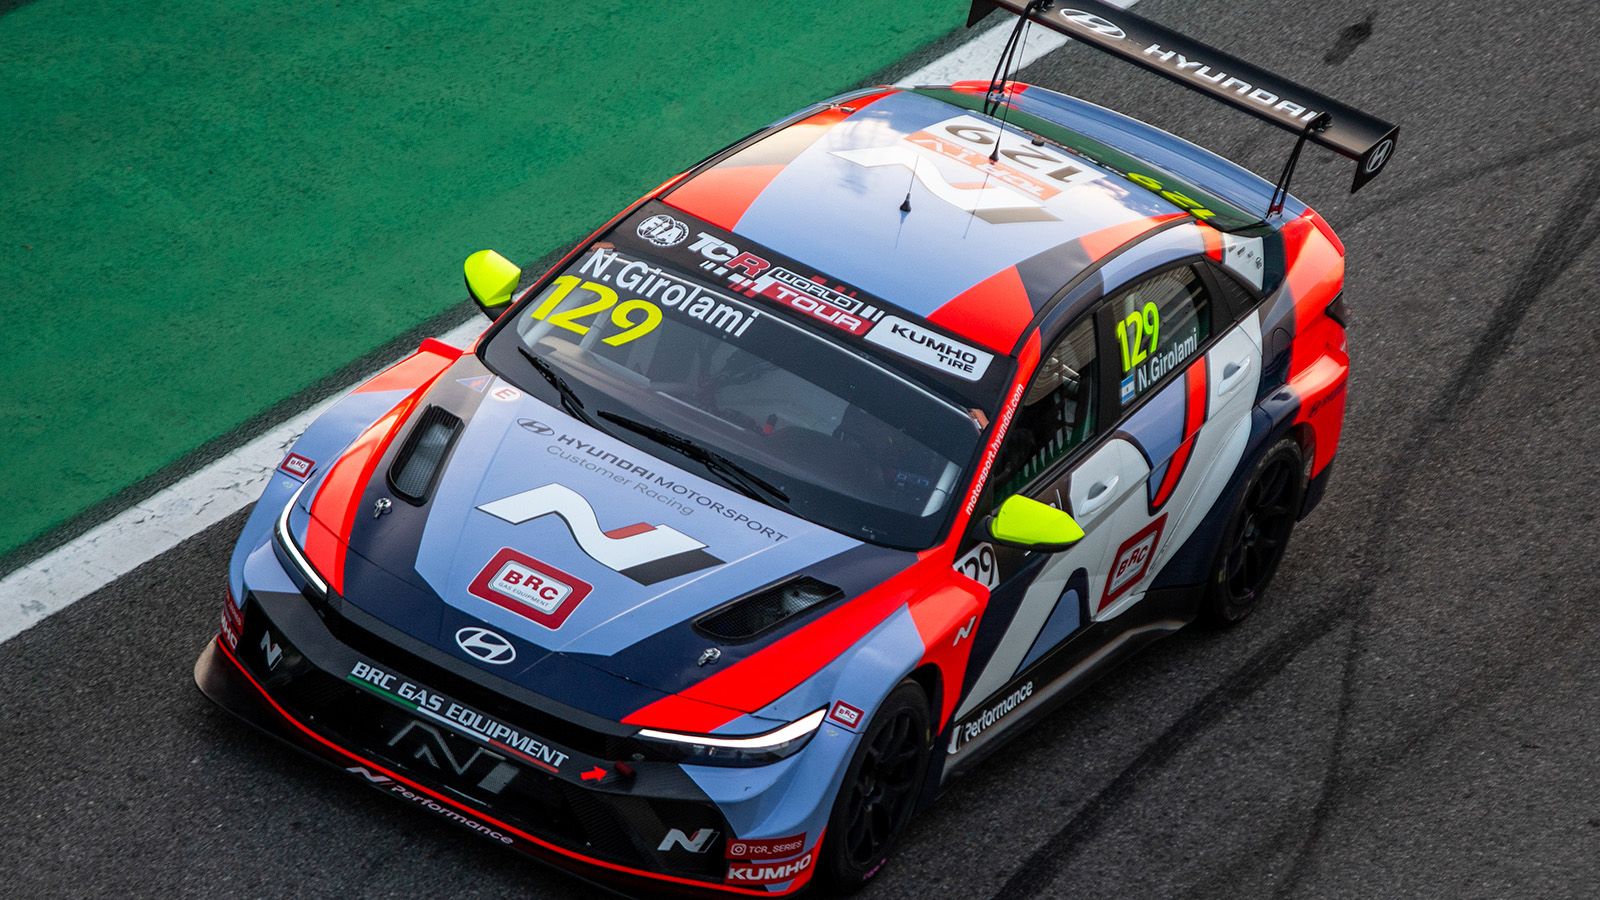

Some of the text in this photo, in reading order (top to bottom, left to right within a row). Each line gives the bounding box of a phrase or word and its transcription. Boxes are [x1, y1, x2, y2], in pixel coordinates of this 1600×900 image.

[1144, 43, 1318, 121] HYUNDAI
[945, 124, 1083, 182] 129
[639, 216, 686, 245] FIA
[688, 232, 770, 278] TCR
[530, 274, 663, 347] 129
[578, 248, 759, 337] N.Girolami
[775, 270, 852, 311] WORLD
[777, 287, 861, 331] TOUR
[891, 324, 978, 364] KUMHO
[1117, 301, 1160, 372] 129
[1138, 327, 1198, 391] N.Girolami
[937, 353, 975, 374] TIRE
[966, 384, 1024, 516] motorsport.hyundai.com
[546, 445, 695, 517] Customer Racing
[1116, 545, 1149, 578] BRC
[497, 582, 551, 608] GAS EQUIPMENT
[503, 569, 559, 601] BRC
[351, 661, 570, 768] BRC GAS EQUIPMENT
[838, 707, 856, 720] BRC
[964, 680, 1033, 742] Performance
[391, 785, 514, 845] Performance
[728, 854, 811, 880] KUMHO
[749, 840, 803, 854] TCR_SERIES
